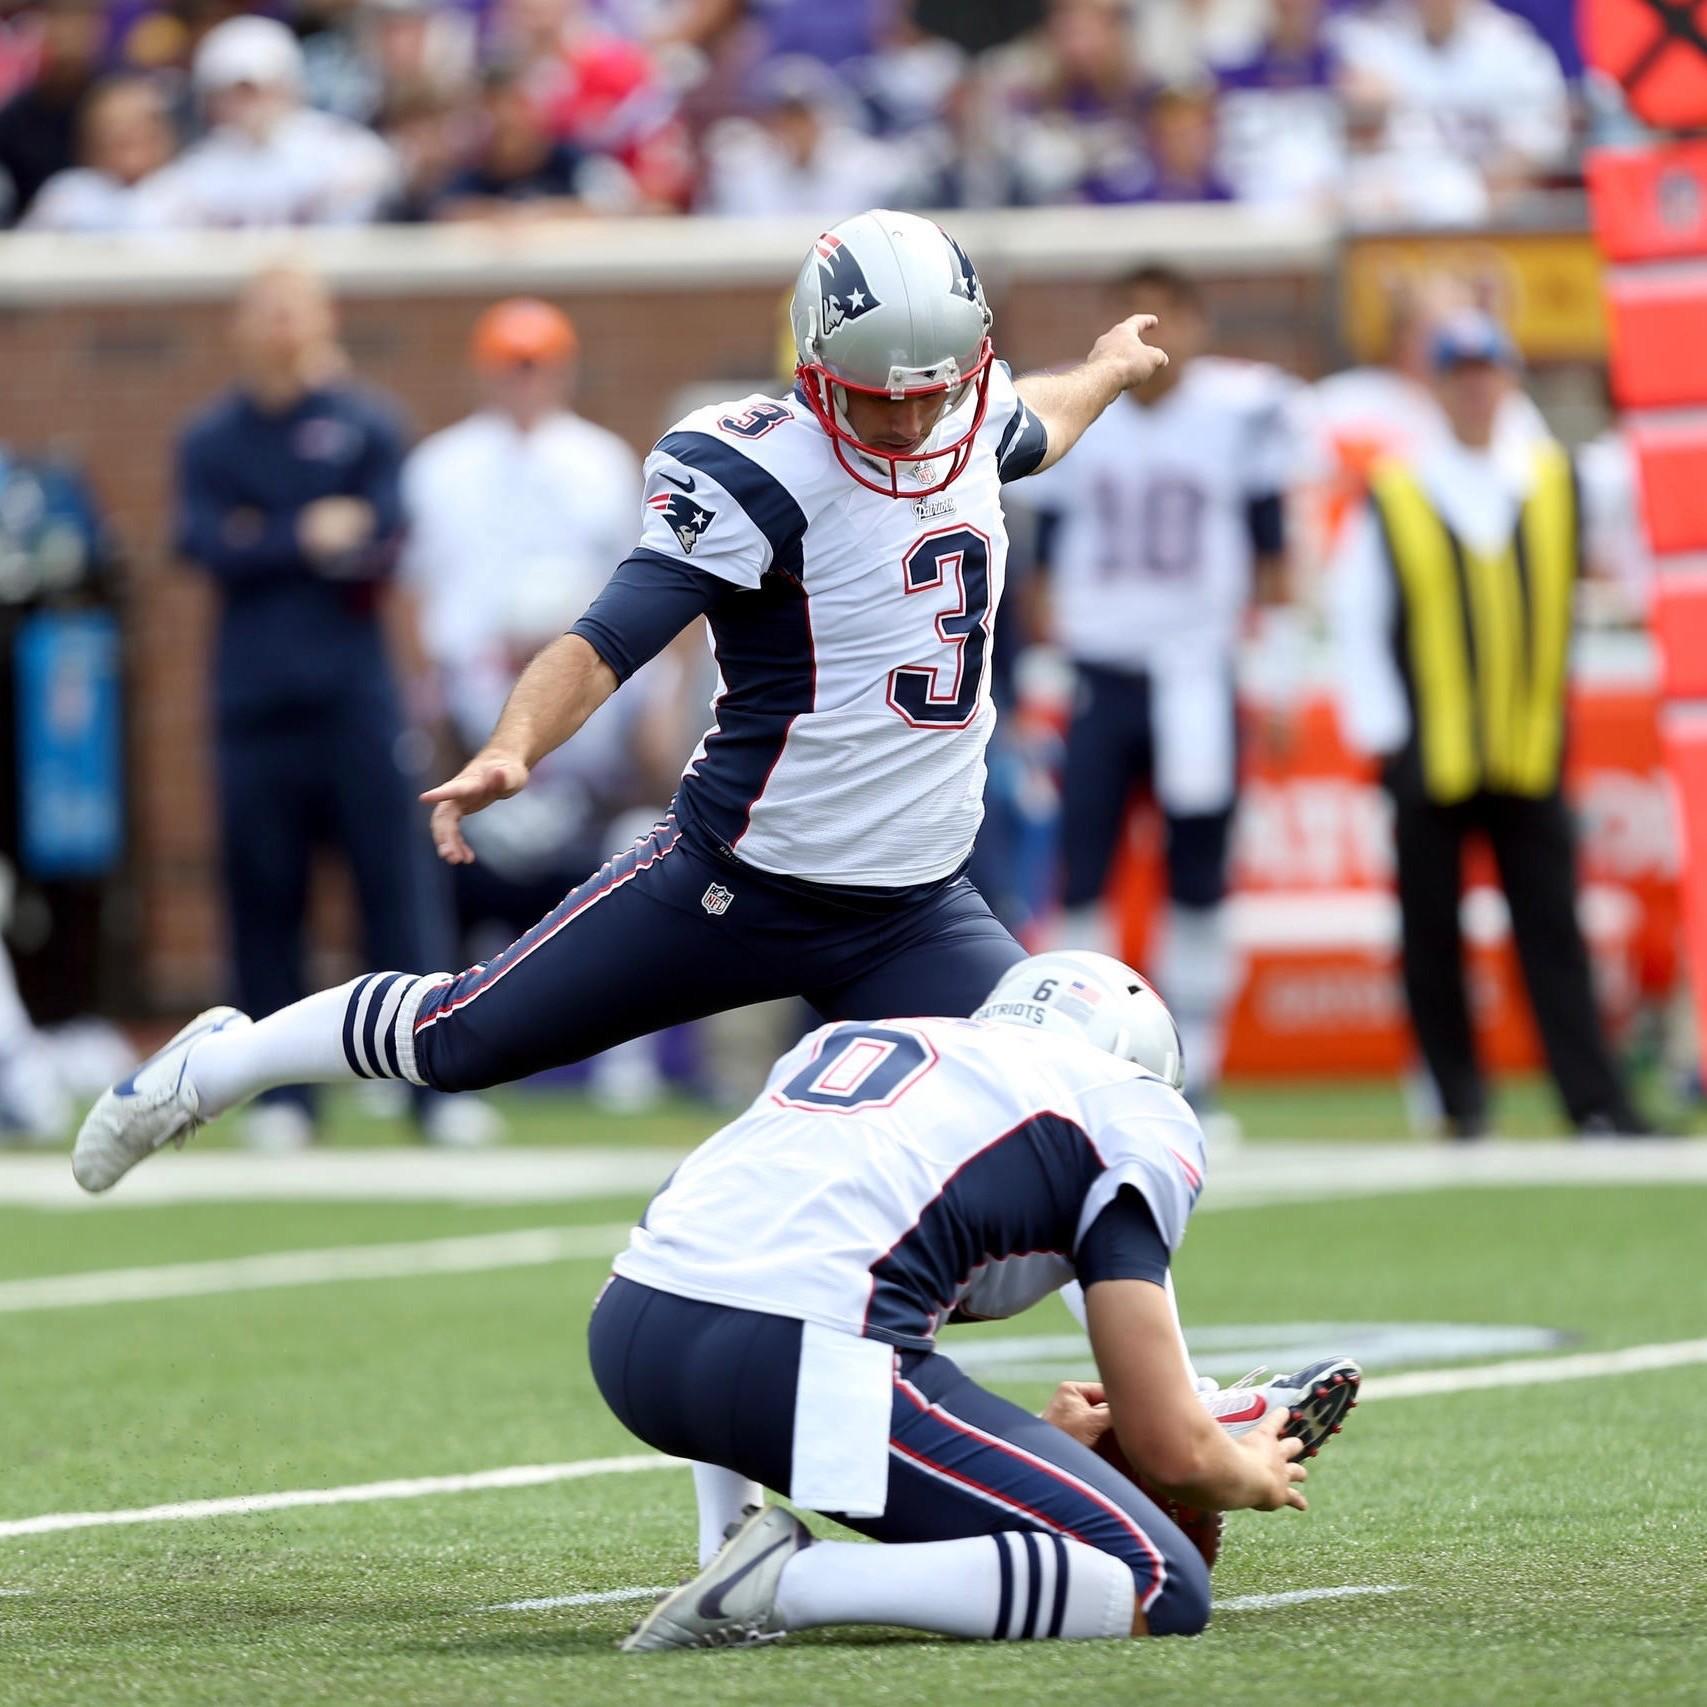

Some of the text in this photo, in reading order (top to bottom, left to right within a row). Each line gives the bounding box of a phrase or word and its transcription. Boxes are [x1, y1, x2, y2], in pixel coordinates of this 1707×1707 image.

[717, 402, 795, 440] 3
[914, 499, 956, 523] Patriots
[886, 523, 992, 729] 3
[704, 893, 727, 913] NFL
[1032, 979, 1059, 1001] 6
